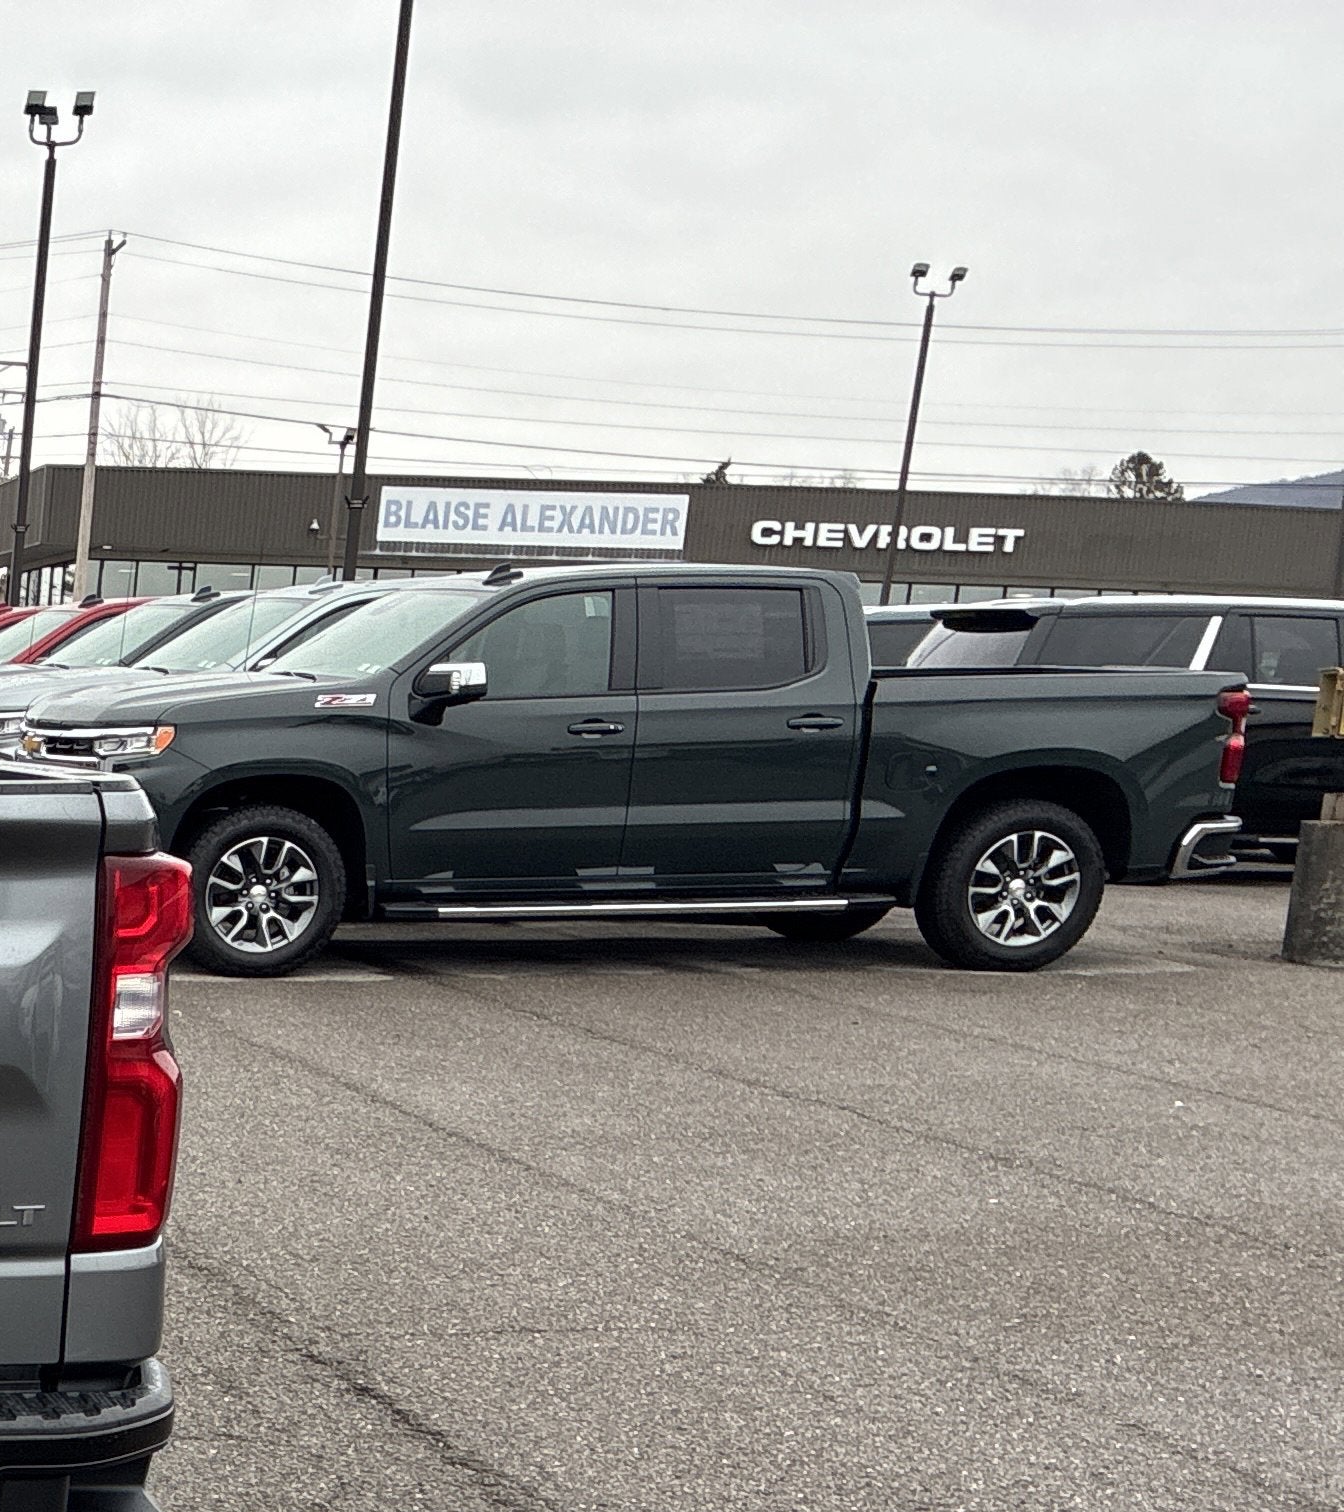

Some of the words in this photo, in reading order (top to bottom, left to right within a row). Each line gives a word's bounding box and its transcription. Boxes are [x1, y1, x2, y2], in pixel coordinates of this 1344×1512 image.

[383, 499, 490, 531] BLAISE
[498, 503, 681, 537] ALEXANDER
[750, 520, 1025, 553] CHEVROLET
